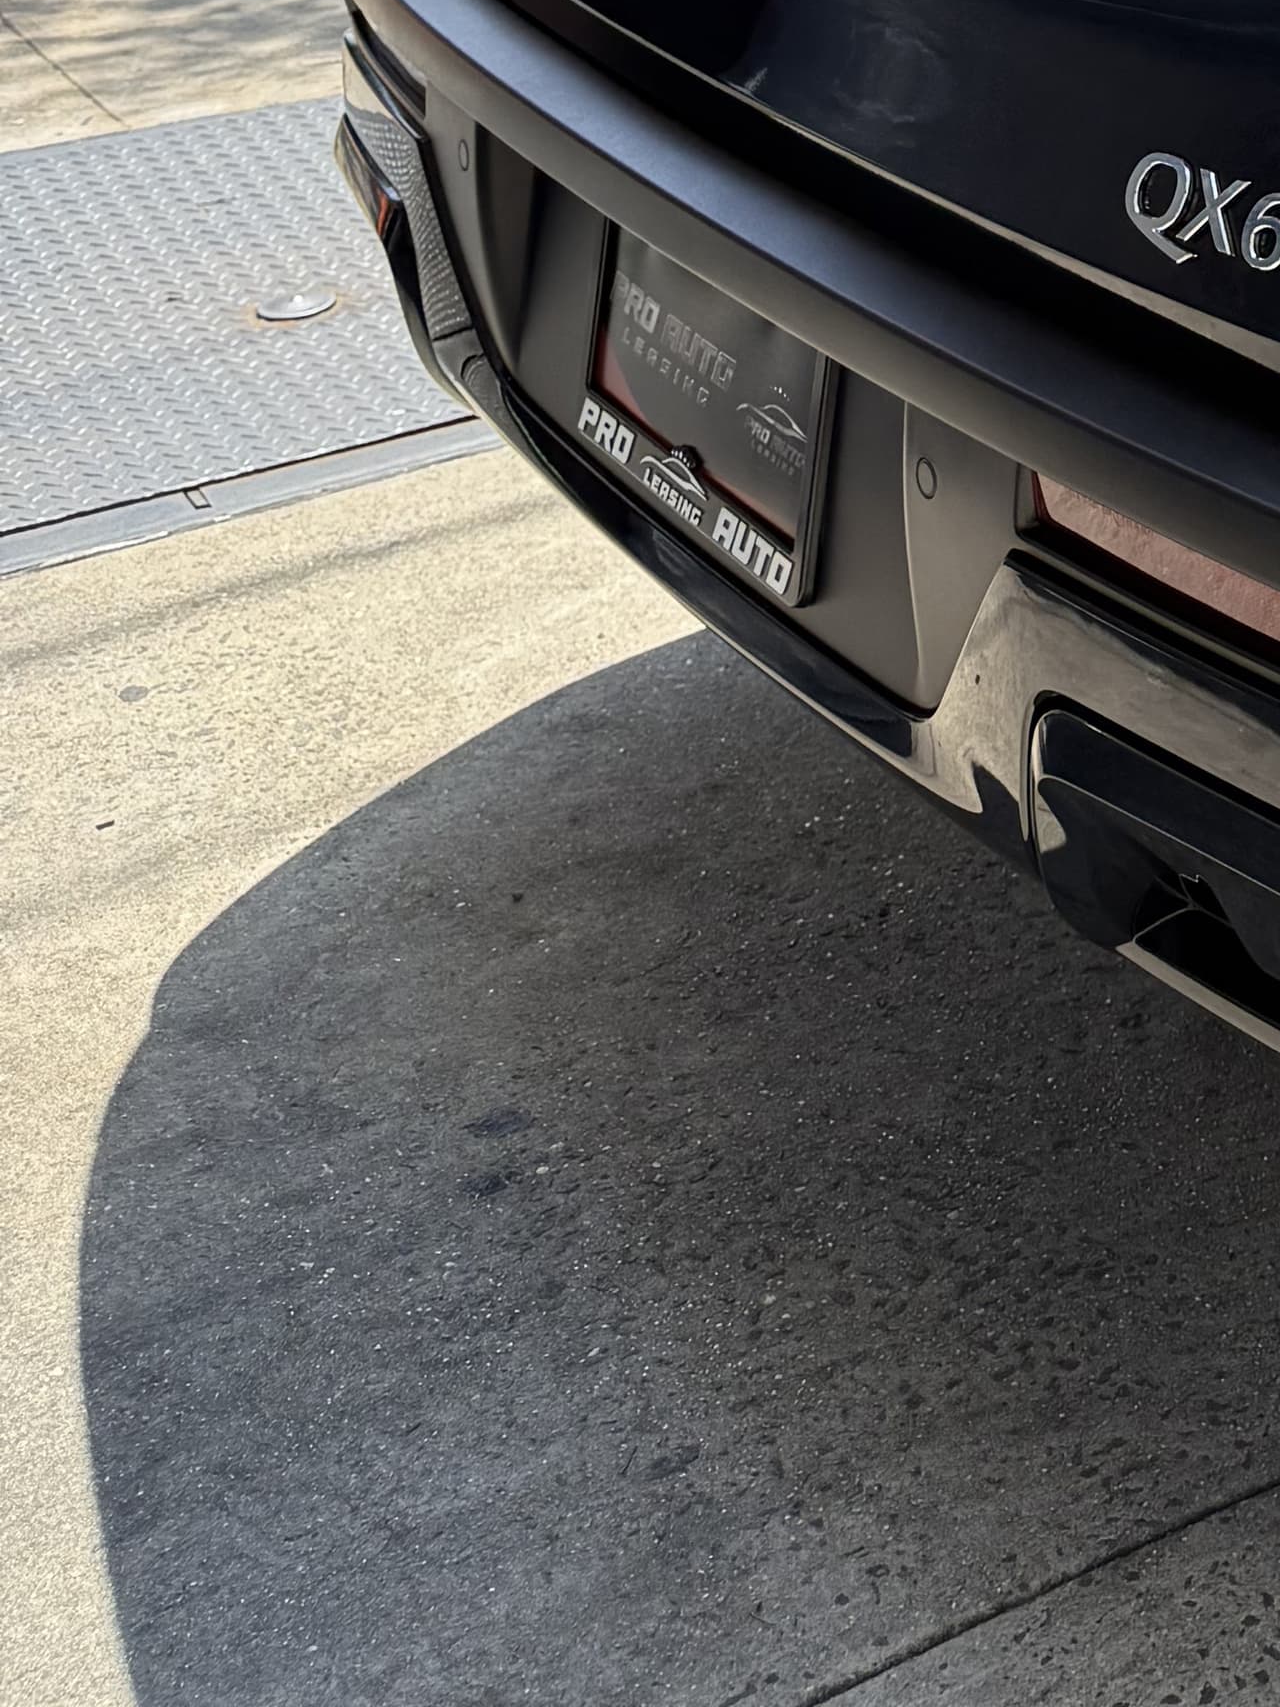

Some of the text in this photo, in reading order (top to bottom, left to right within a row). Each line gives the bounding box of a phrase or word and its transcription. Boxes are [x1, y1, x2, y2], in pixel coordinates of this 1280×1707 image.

[611, 269, 738, 392] PRO AUTO
[622, 326, 710, 406] LEASING
[577, 397, 637, 467] PRO
[641, 467, 703, 528] LEASING
[711, 506, 795, 596] AUTO
